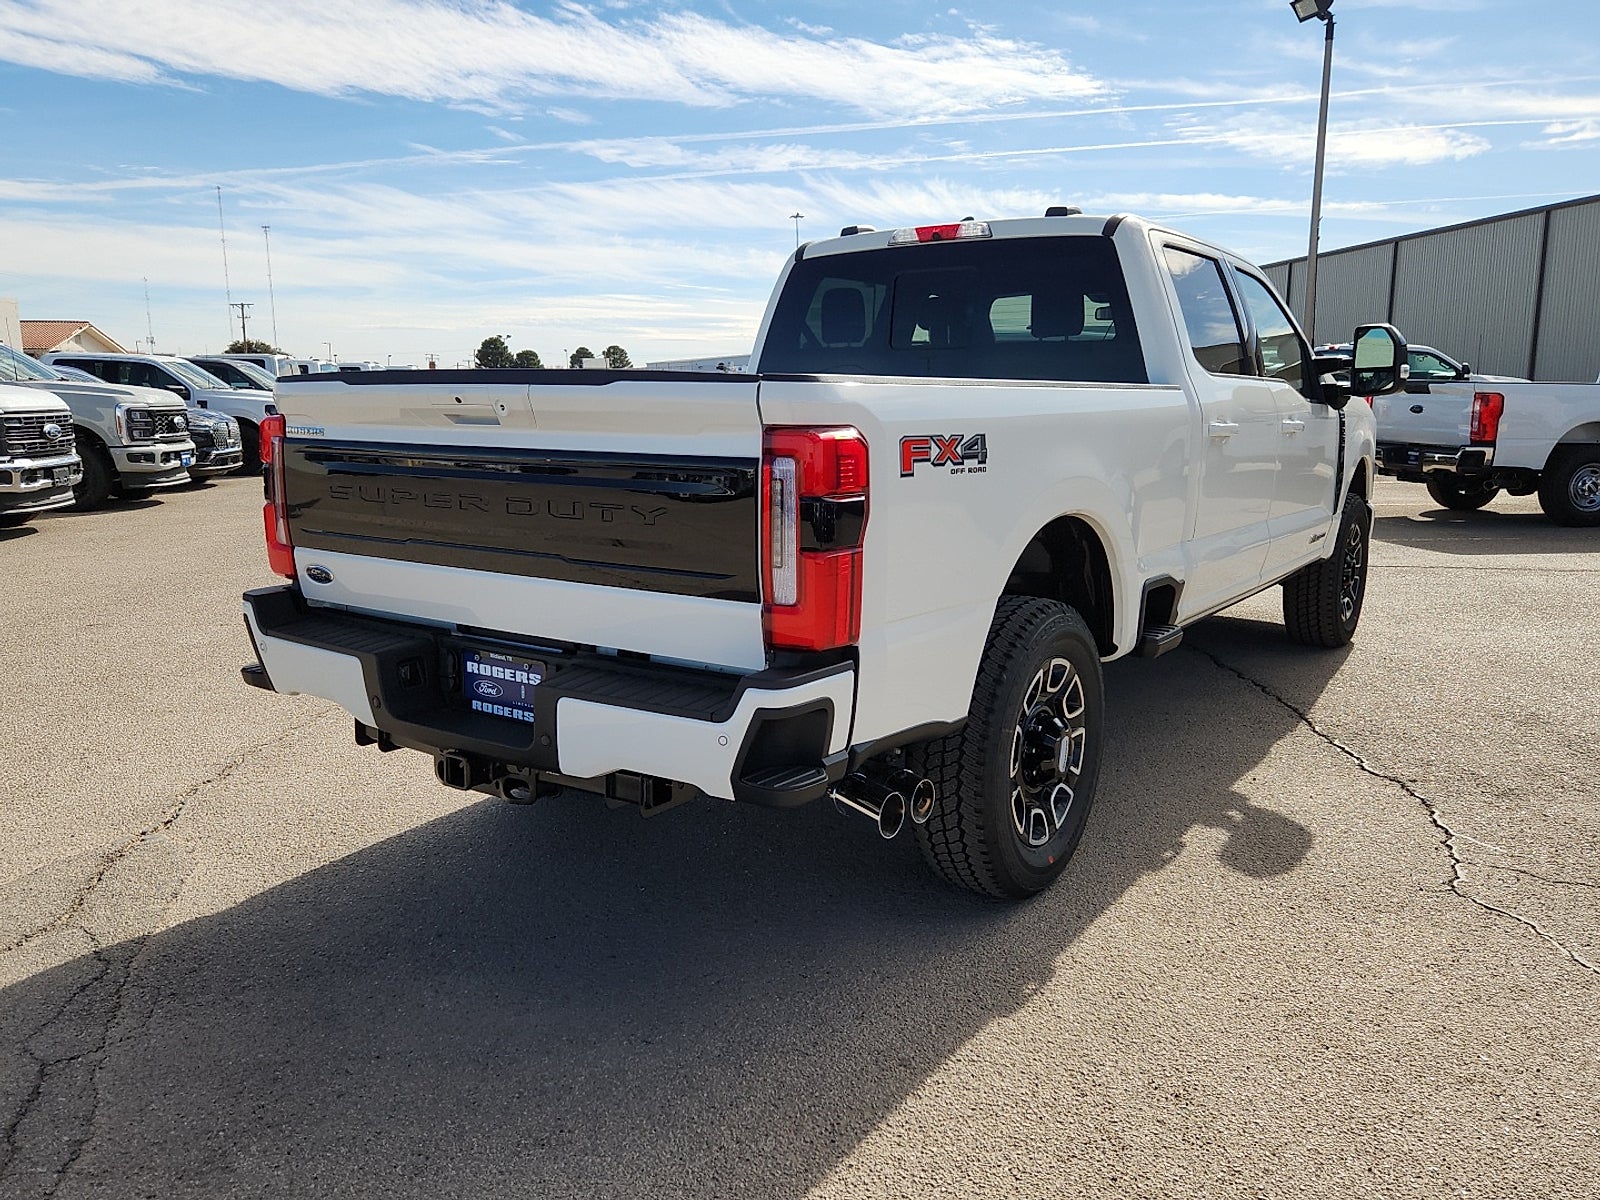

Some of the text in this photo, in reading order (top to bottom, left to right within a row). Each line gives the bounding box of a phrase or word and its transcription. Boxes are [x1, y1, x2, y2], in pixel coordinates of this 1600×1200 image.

[899, 433, 988, 478] FX4
[950, 466, 987, 475] OFF ROAD
[330, 485, 668, 526] SUPER DUTY
[466, 661, 542, 686] ROGERS
[471, 700, 535, 722] ROGERS
